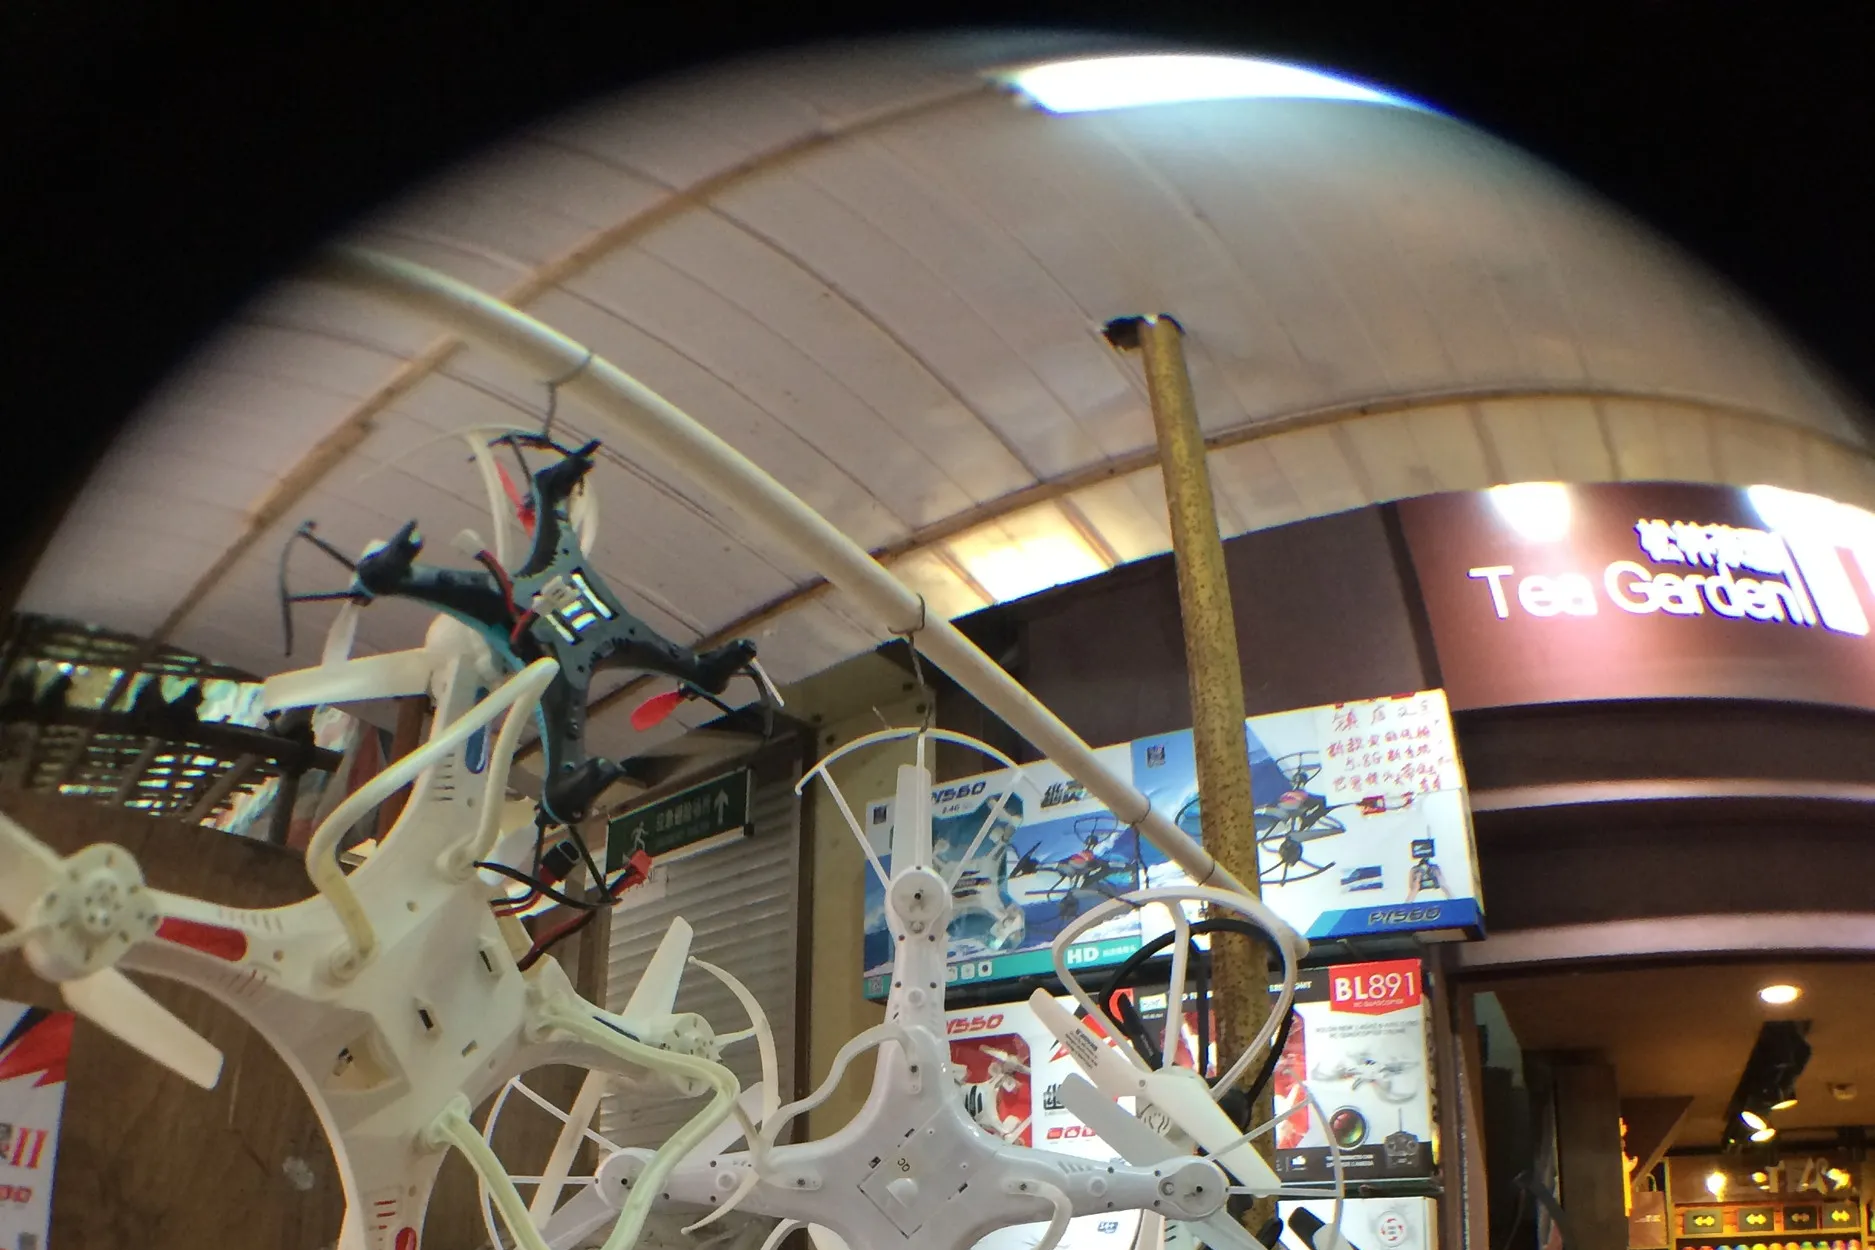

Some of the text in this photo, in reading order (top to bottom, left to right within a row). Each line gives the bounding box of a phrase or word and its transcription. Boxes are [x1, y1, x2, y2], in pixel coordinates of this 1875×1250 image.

[1468, 560, 1803, 626] Tea Garden
[932, 781, 987, 804] Y560
[1067, 944, 1099, 965] HD
[1335, 972, 1415, 1002] BL891
[946, 1013, 1004, 1035] Y550
